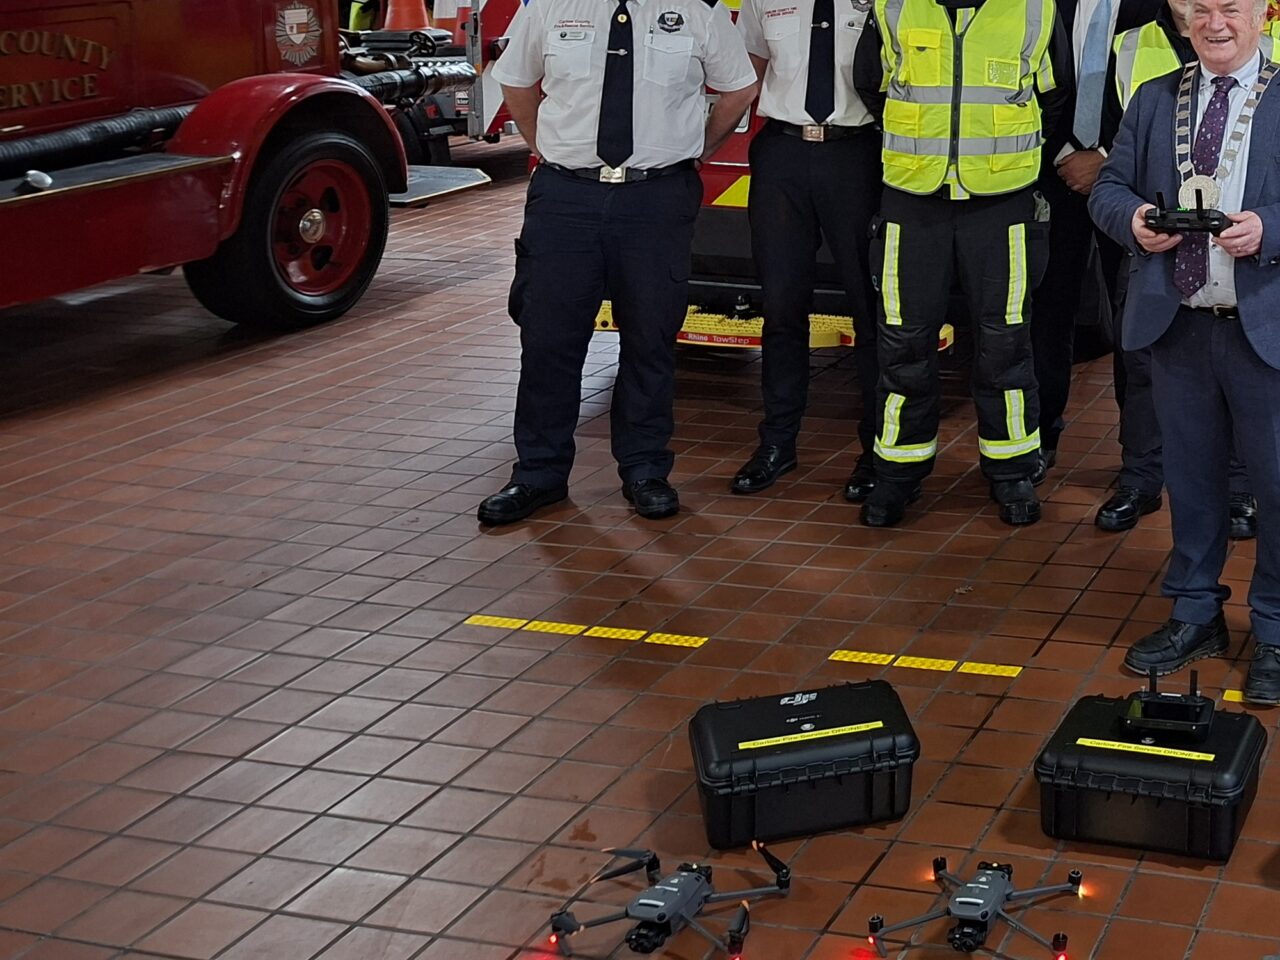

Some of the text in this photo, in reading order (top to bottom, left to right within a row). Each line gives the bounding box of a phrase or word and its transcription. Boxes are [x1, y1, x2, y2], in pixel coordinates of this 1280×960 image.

[0, 30, 117, 71] COUNTY
[0, 73, 97, 110] ERVICE
[688, 333, 750, 344] Rhino TowStep
